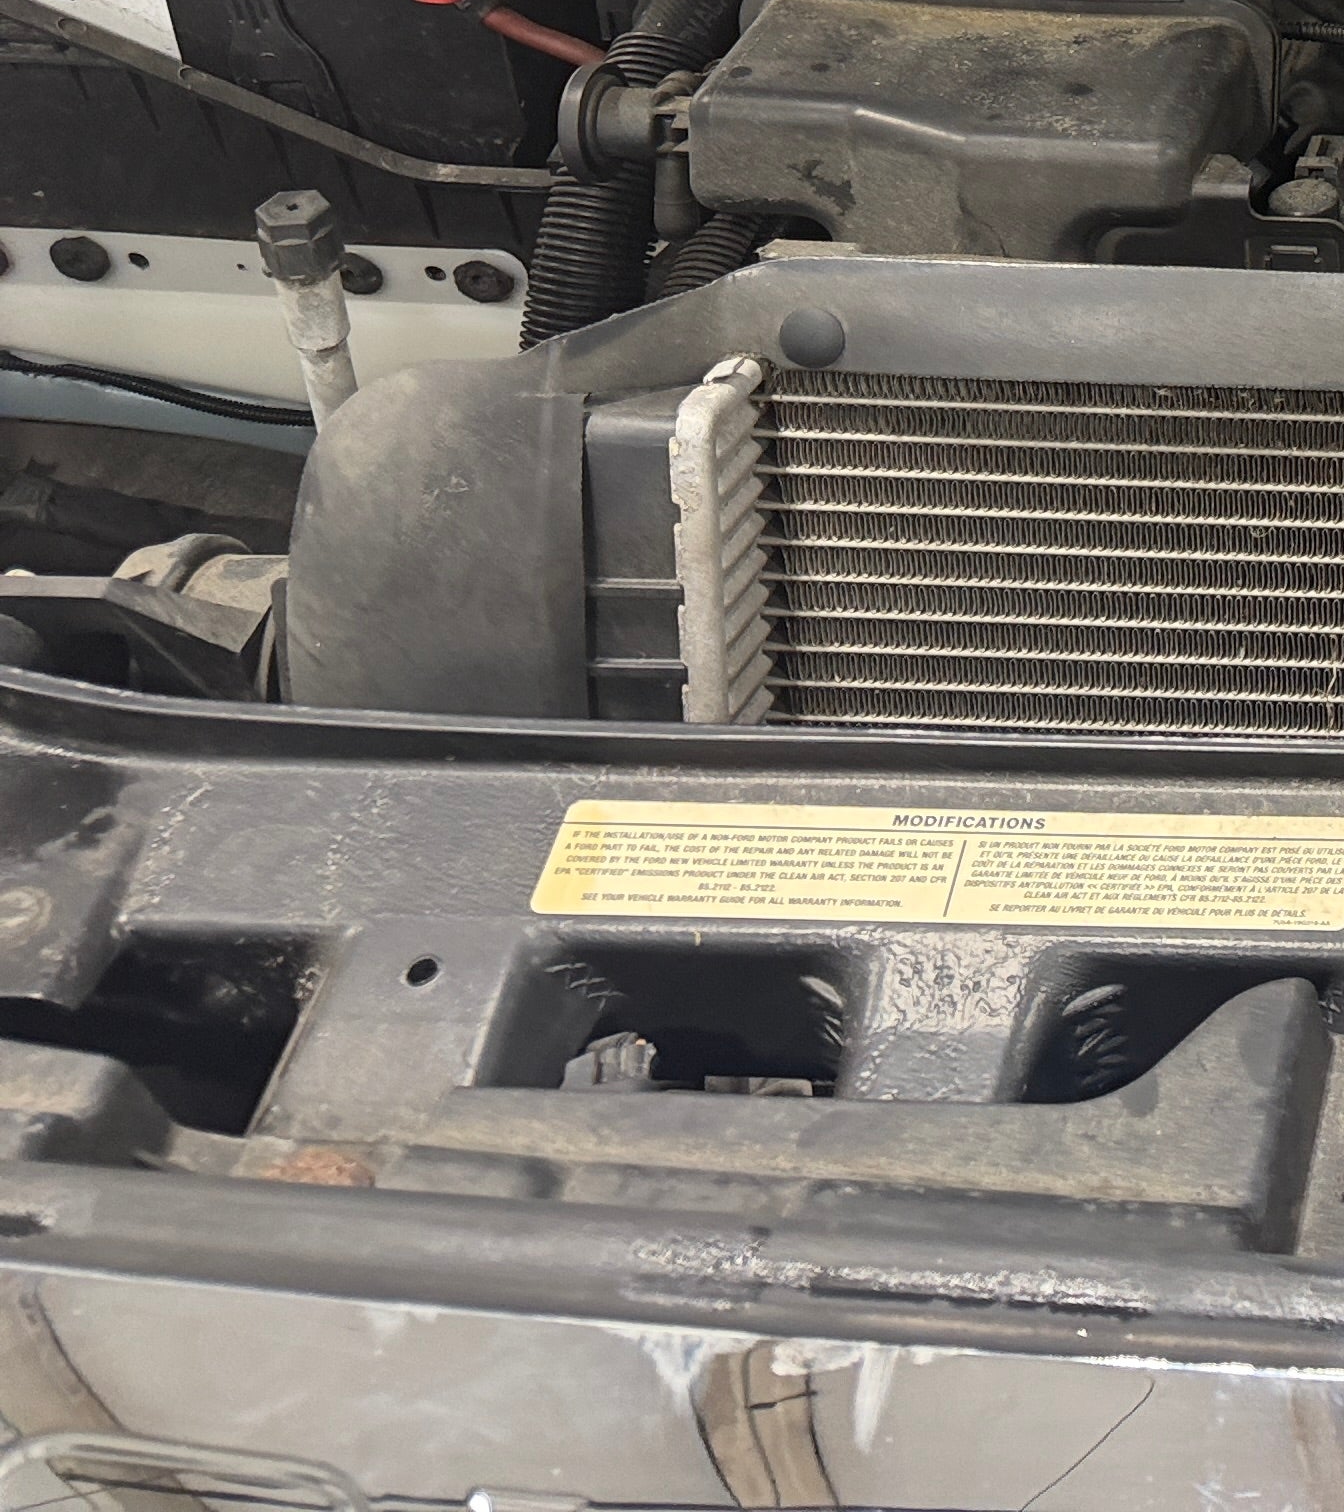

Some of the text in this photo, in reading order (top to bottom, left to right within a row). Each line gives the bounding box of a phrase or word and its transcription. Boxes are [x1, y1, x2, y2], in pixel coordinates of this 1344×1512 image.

[892, 814, 1046, 830] MODIFICATIONS
[710, 834, 754, 842] NON-FORD
[758, 835, 788, 843] MOTOR
[790, 836, 832, 844] COMPANY
[835, 837, 876, 845] PRODUCT
[878, 838, 902, 846] FAILS
[920, 839, 953, 847] CAUSES
[817, 849, 856, 857] RELATED
[859, 850, 894, 858] DAMAGE
[566, 856, 606, 864] COVERED
[769, 860, 818, 868] WARRANTY
[760, 872, 775, 880] THE
[849, 874, 886, 882] SECTION
[581, 893, 597, 901] SEE
[628, 894, 663, 902] VEHICLE
[667, 895, 716, 903] WARRANTY
[719, 896, 744, 904] GUIDE
[768, 897, 783, 905] ALL
[788, 898, 837, 906] WARRANTY
